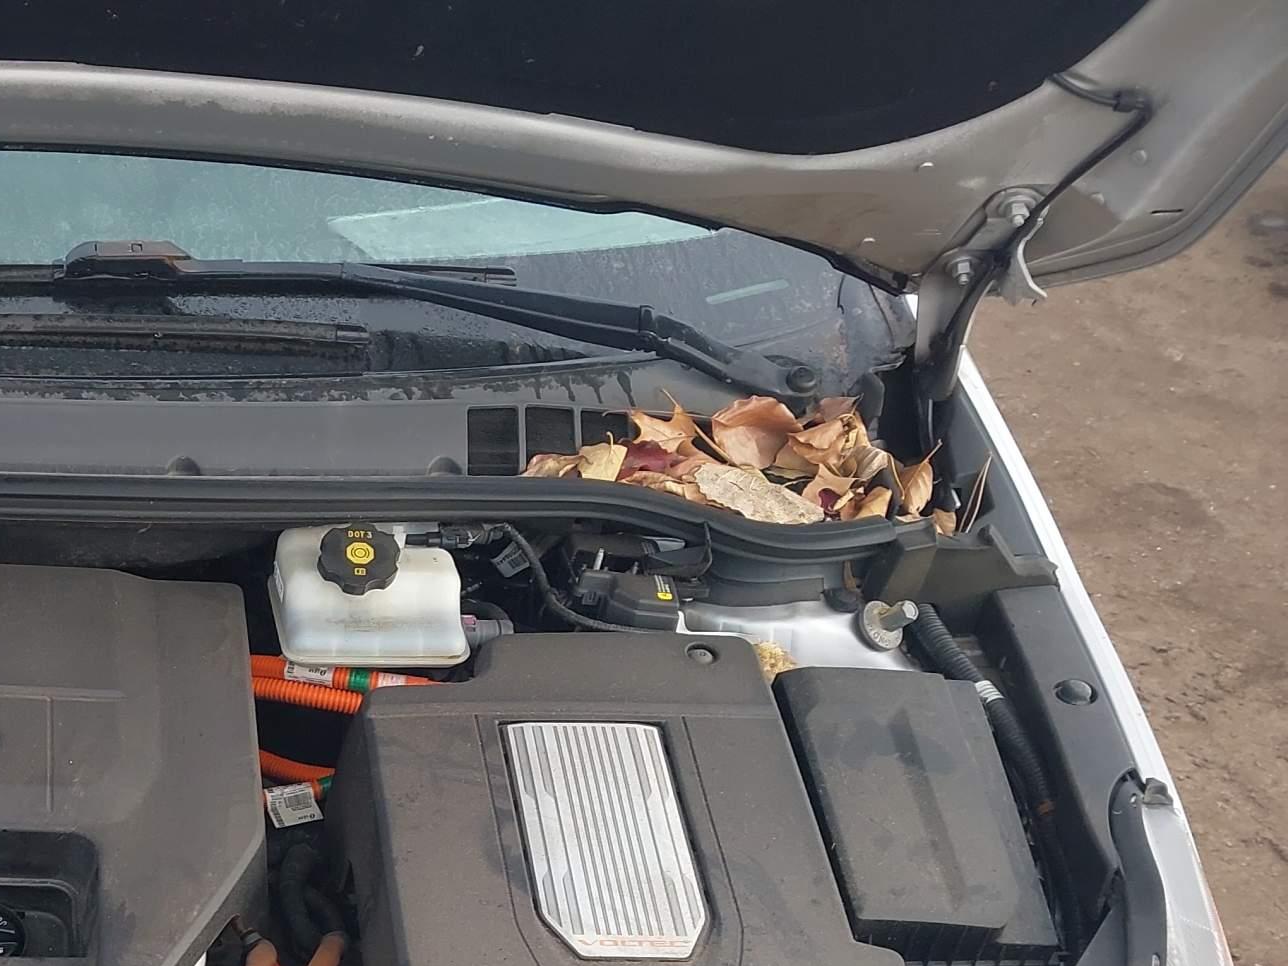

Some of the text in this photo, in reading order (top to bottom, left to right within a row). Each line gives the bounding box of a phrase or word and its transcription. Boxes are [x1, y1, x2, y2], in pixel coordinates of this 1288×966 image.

[347, 530, 373, 539] DOT 3
[577, 938, 692, 948] VOLTEC
